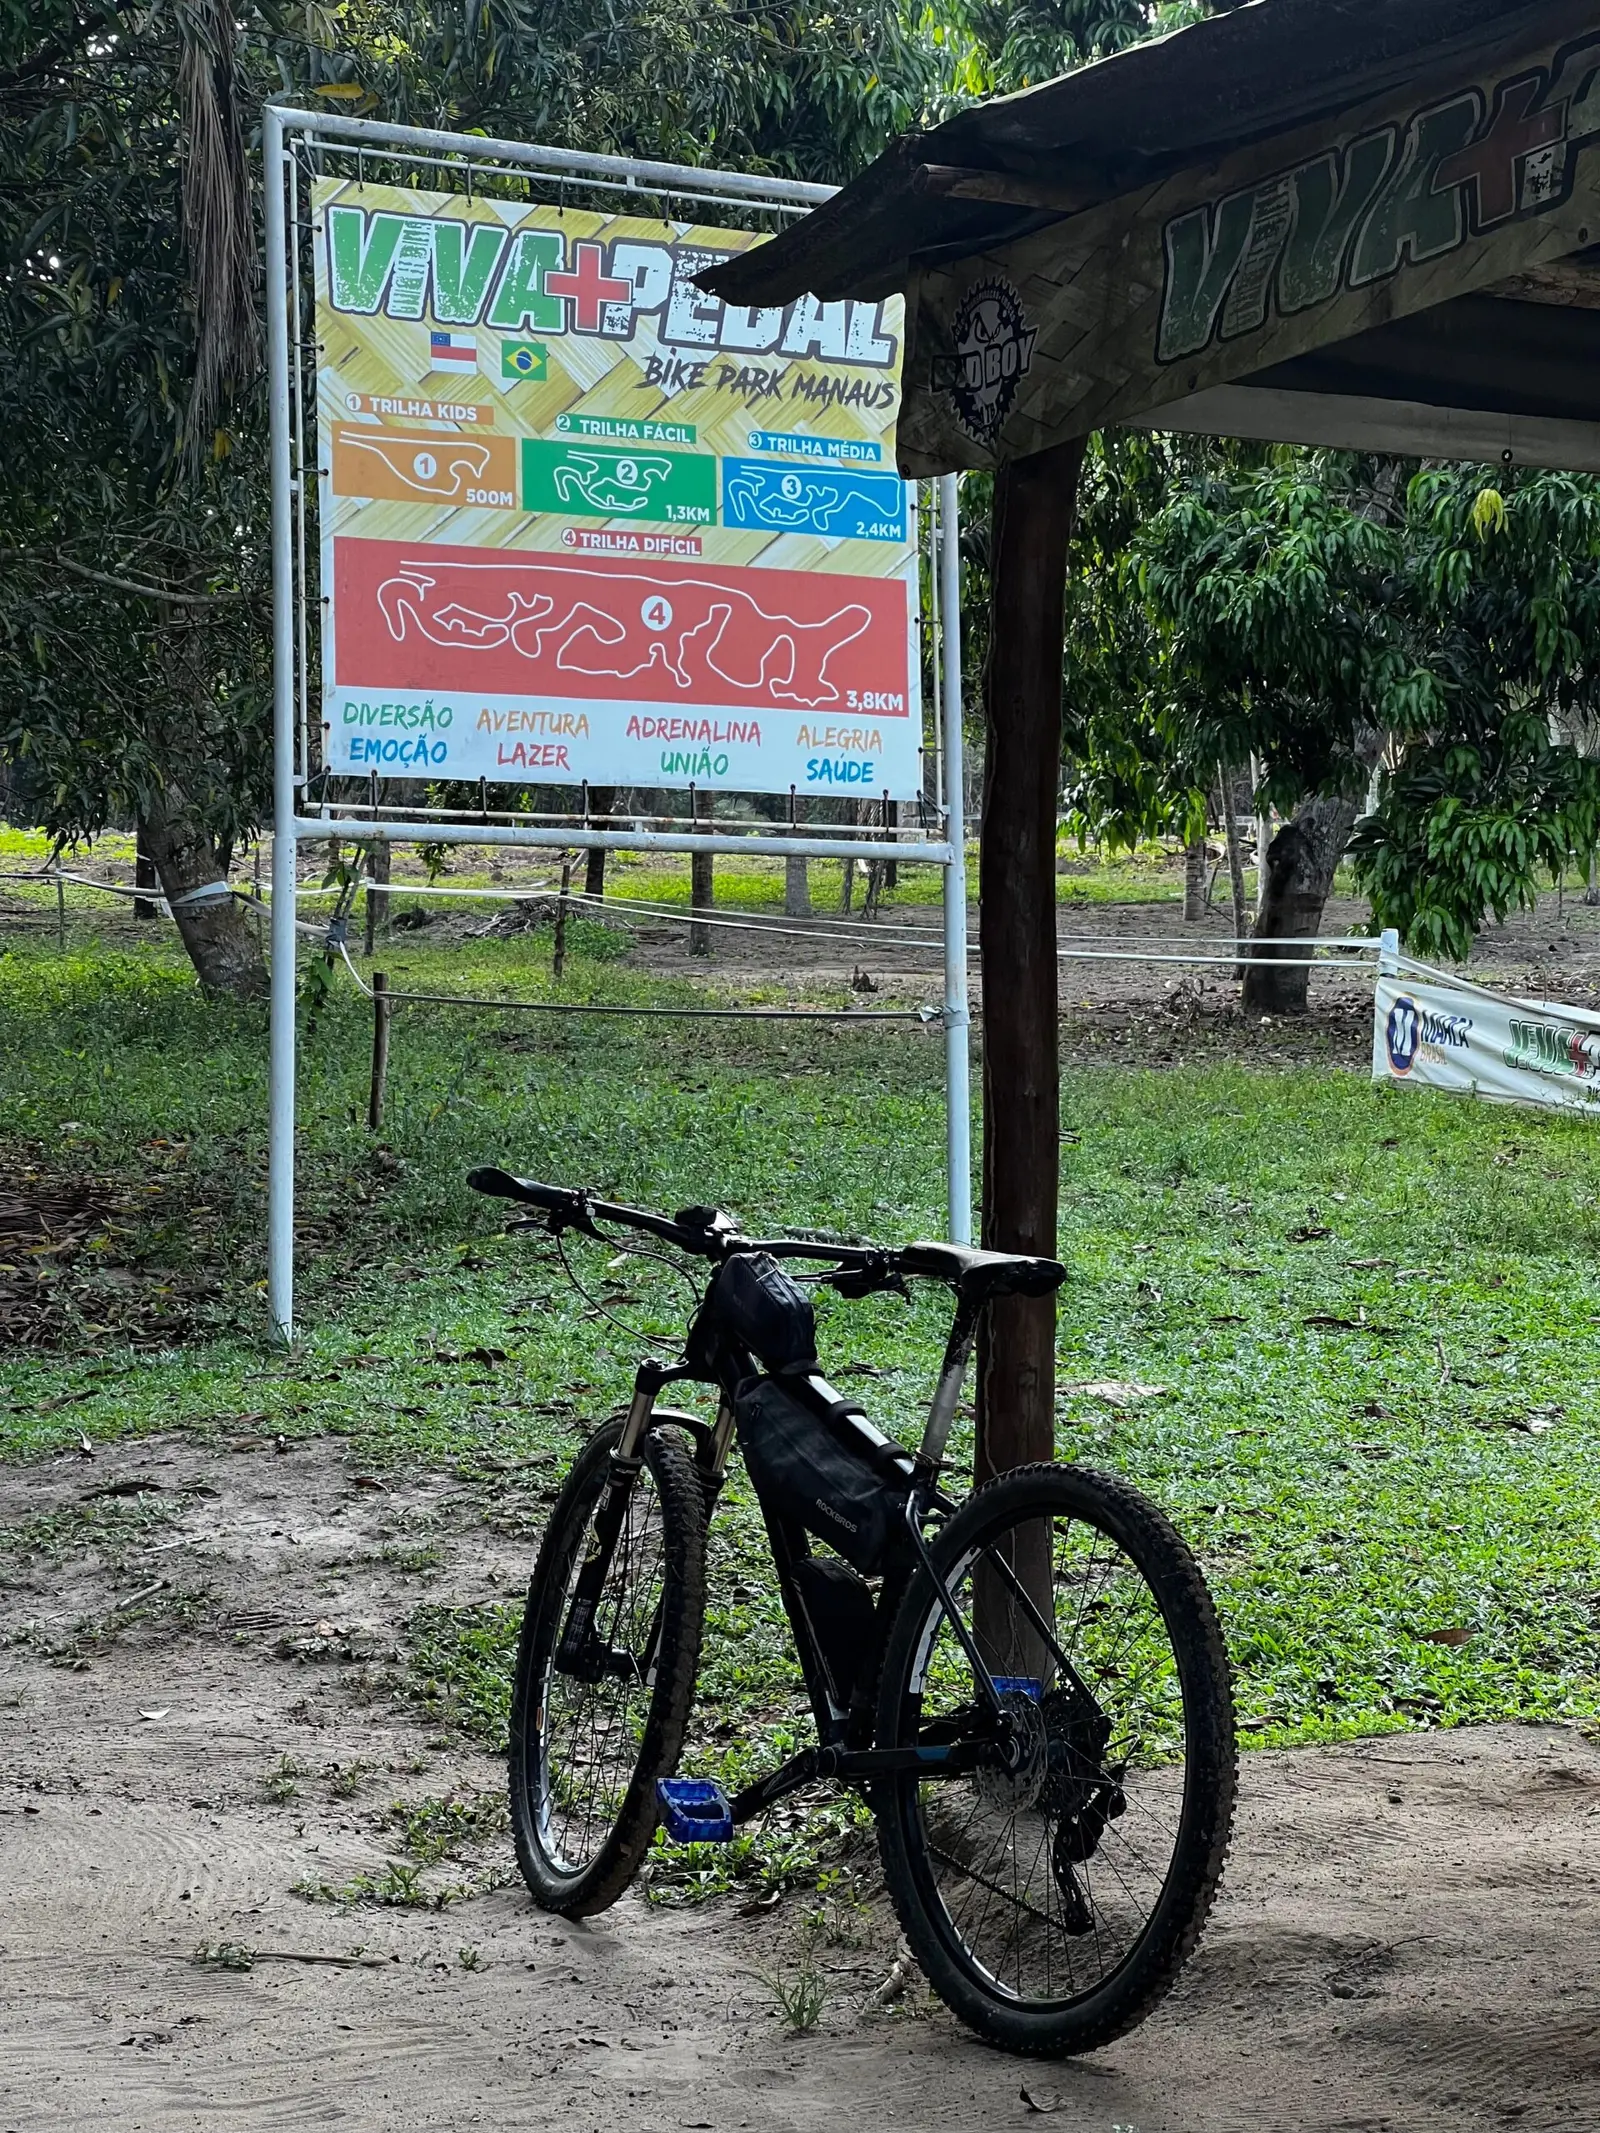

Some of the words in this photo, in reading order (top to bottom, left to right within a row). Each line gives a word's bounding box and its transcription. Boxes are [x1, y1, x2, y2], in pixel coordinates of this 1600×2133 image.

[986, 332, 1036, 385] BOY
[633, 347, 710, 391] BIKE
[716, 364, 785, 400] PARK
[791, 372, 895, 411] MANAUS
[369, 396, 433, 417] TRILHA
[437, 405, 477, 421] KIDS
[579, 419, 639, 438] TRILHA
[643, 422, 690, 442] FÁCIL
[767, 437, 823, 455] TRILHA
[828, 441, 876, 460] MÉDIA
[466, 489, 513, 506] 500M
[665, 504, 710, 522] 1,3KM
[580, 532, 639, 550] TRILHA
[644, 535, 701, 555] DIFÍCIL
[856, 521, 901, 538] 2,4KM
[342, 699, 454, 731] DIVERSÃO
[846, 690, 904, 712] 3,8KM
[475, 708, 590, 740] AVENTURA
[626, 715, 762, 747] ADRENALINA
[796, 724, 882, 754] ALEGRIA
[349, 733, 448, 768] EMOÇÃO
[496, 742, 571, 771] LAZER
[660, 746, 730, 779] UNIÃO
[806, 754, 875, 784] SAÚDE
[815, 1497, 858, 1533] ROCKBROS
